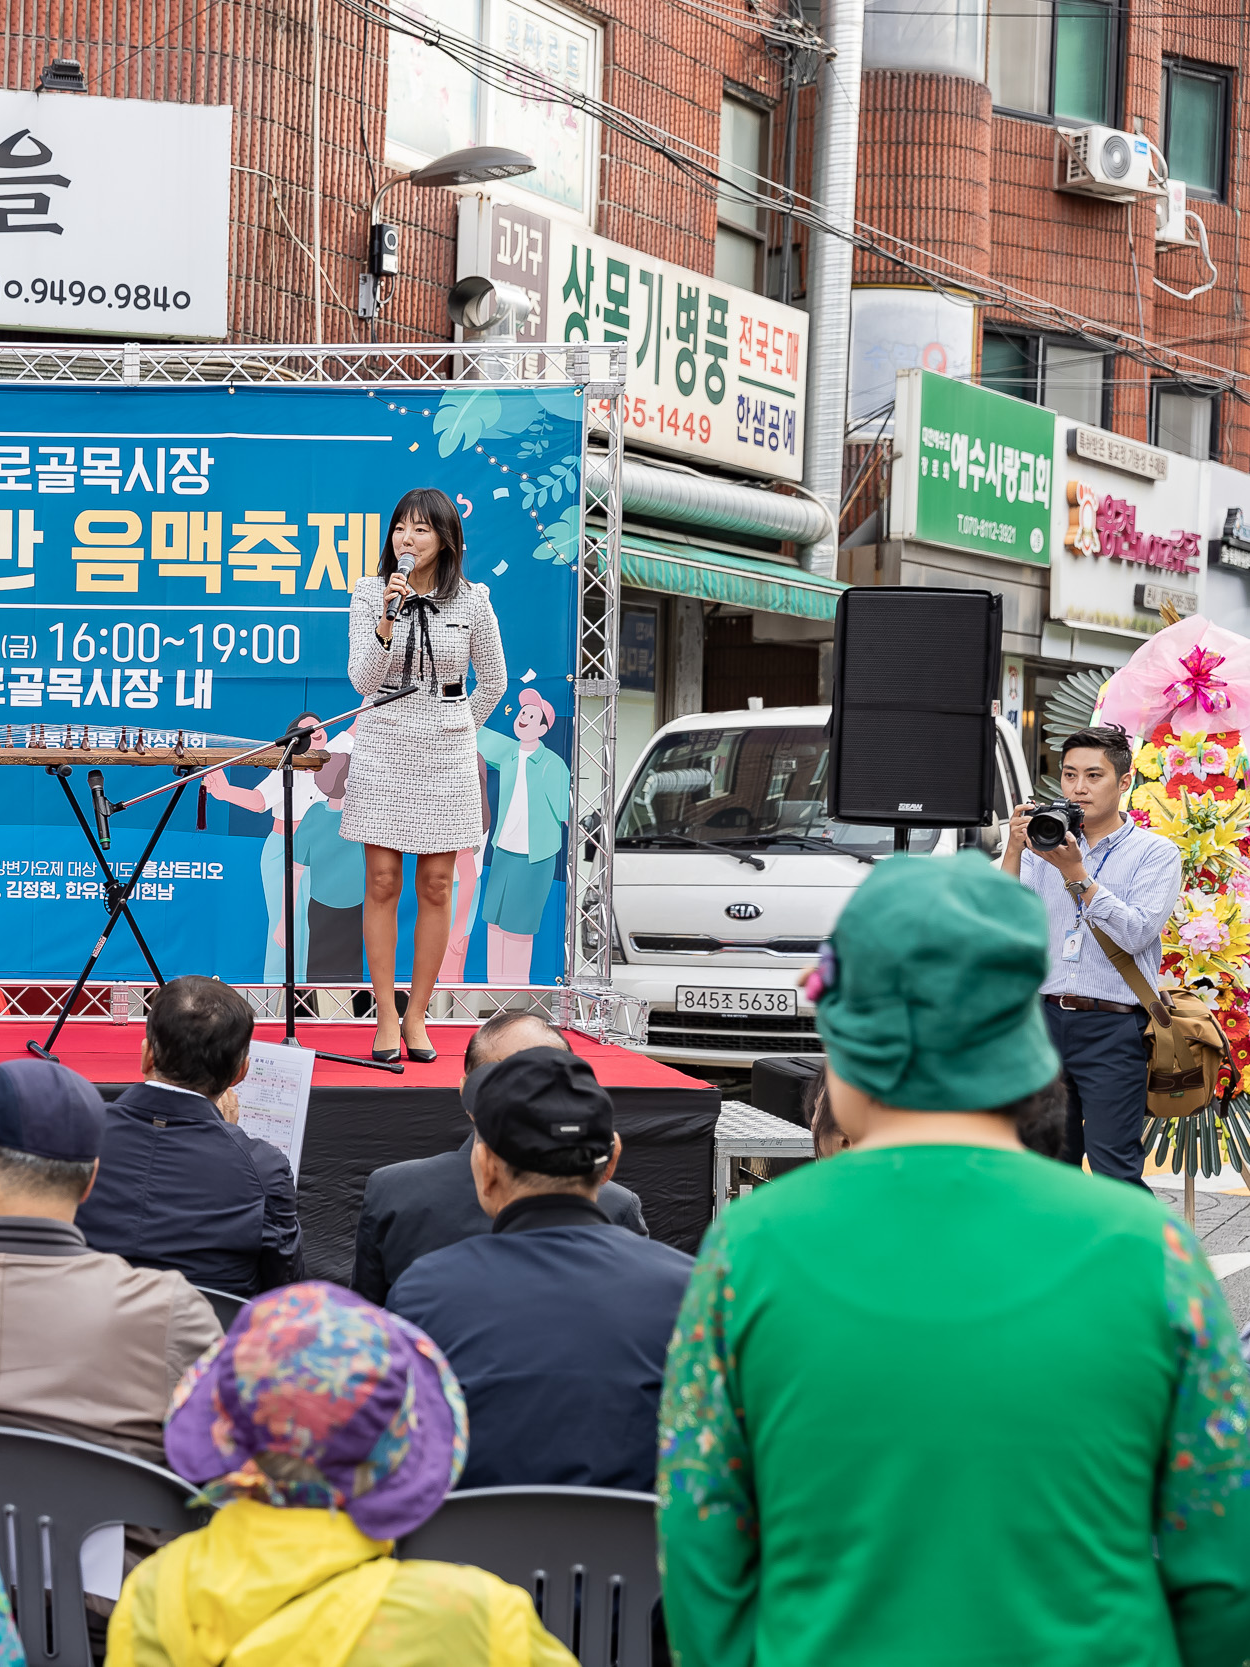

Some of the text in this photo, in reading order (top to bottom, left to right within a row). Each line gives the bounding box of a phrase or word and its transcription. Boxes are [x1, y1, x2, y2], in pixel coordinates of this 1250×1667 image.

[497, 217, 543, 276] 고가구
[739, 315, 799, 382] 전국도매
[737, 394, 796, 456] 한샘공예
[951, 432, 1051, 510] 예수사랑교회
[71, 509, 380, 594] 음맥축제
[49, 622, 300, 663] 16:00~19:00
[174, 668, 213, 711] 내
[6, 881, 61, 900] 김정현,
[67, 861, 98, 878] 대상
[141, 860, 224, 880] 홍삼트리오
[730, 905, 756, 918] KIA
[738, 993, 788, 1012] 5638
